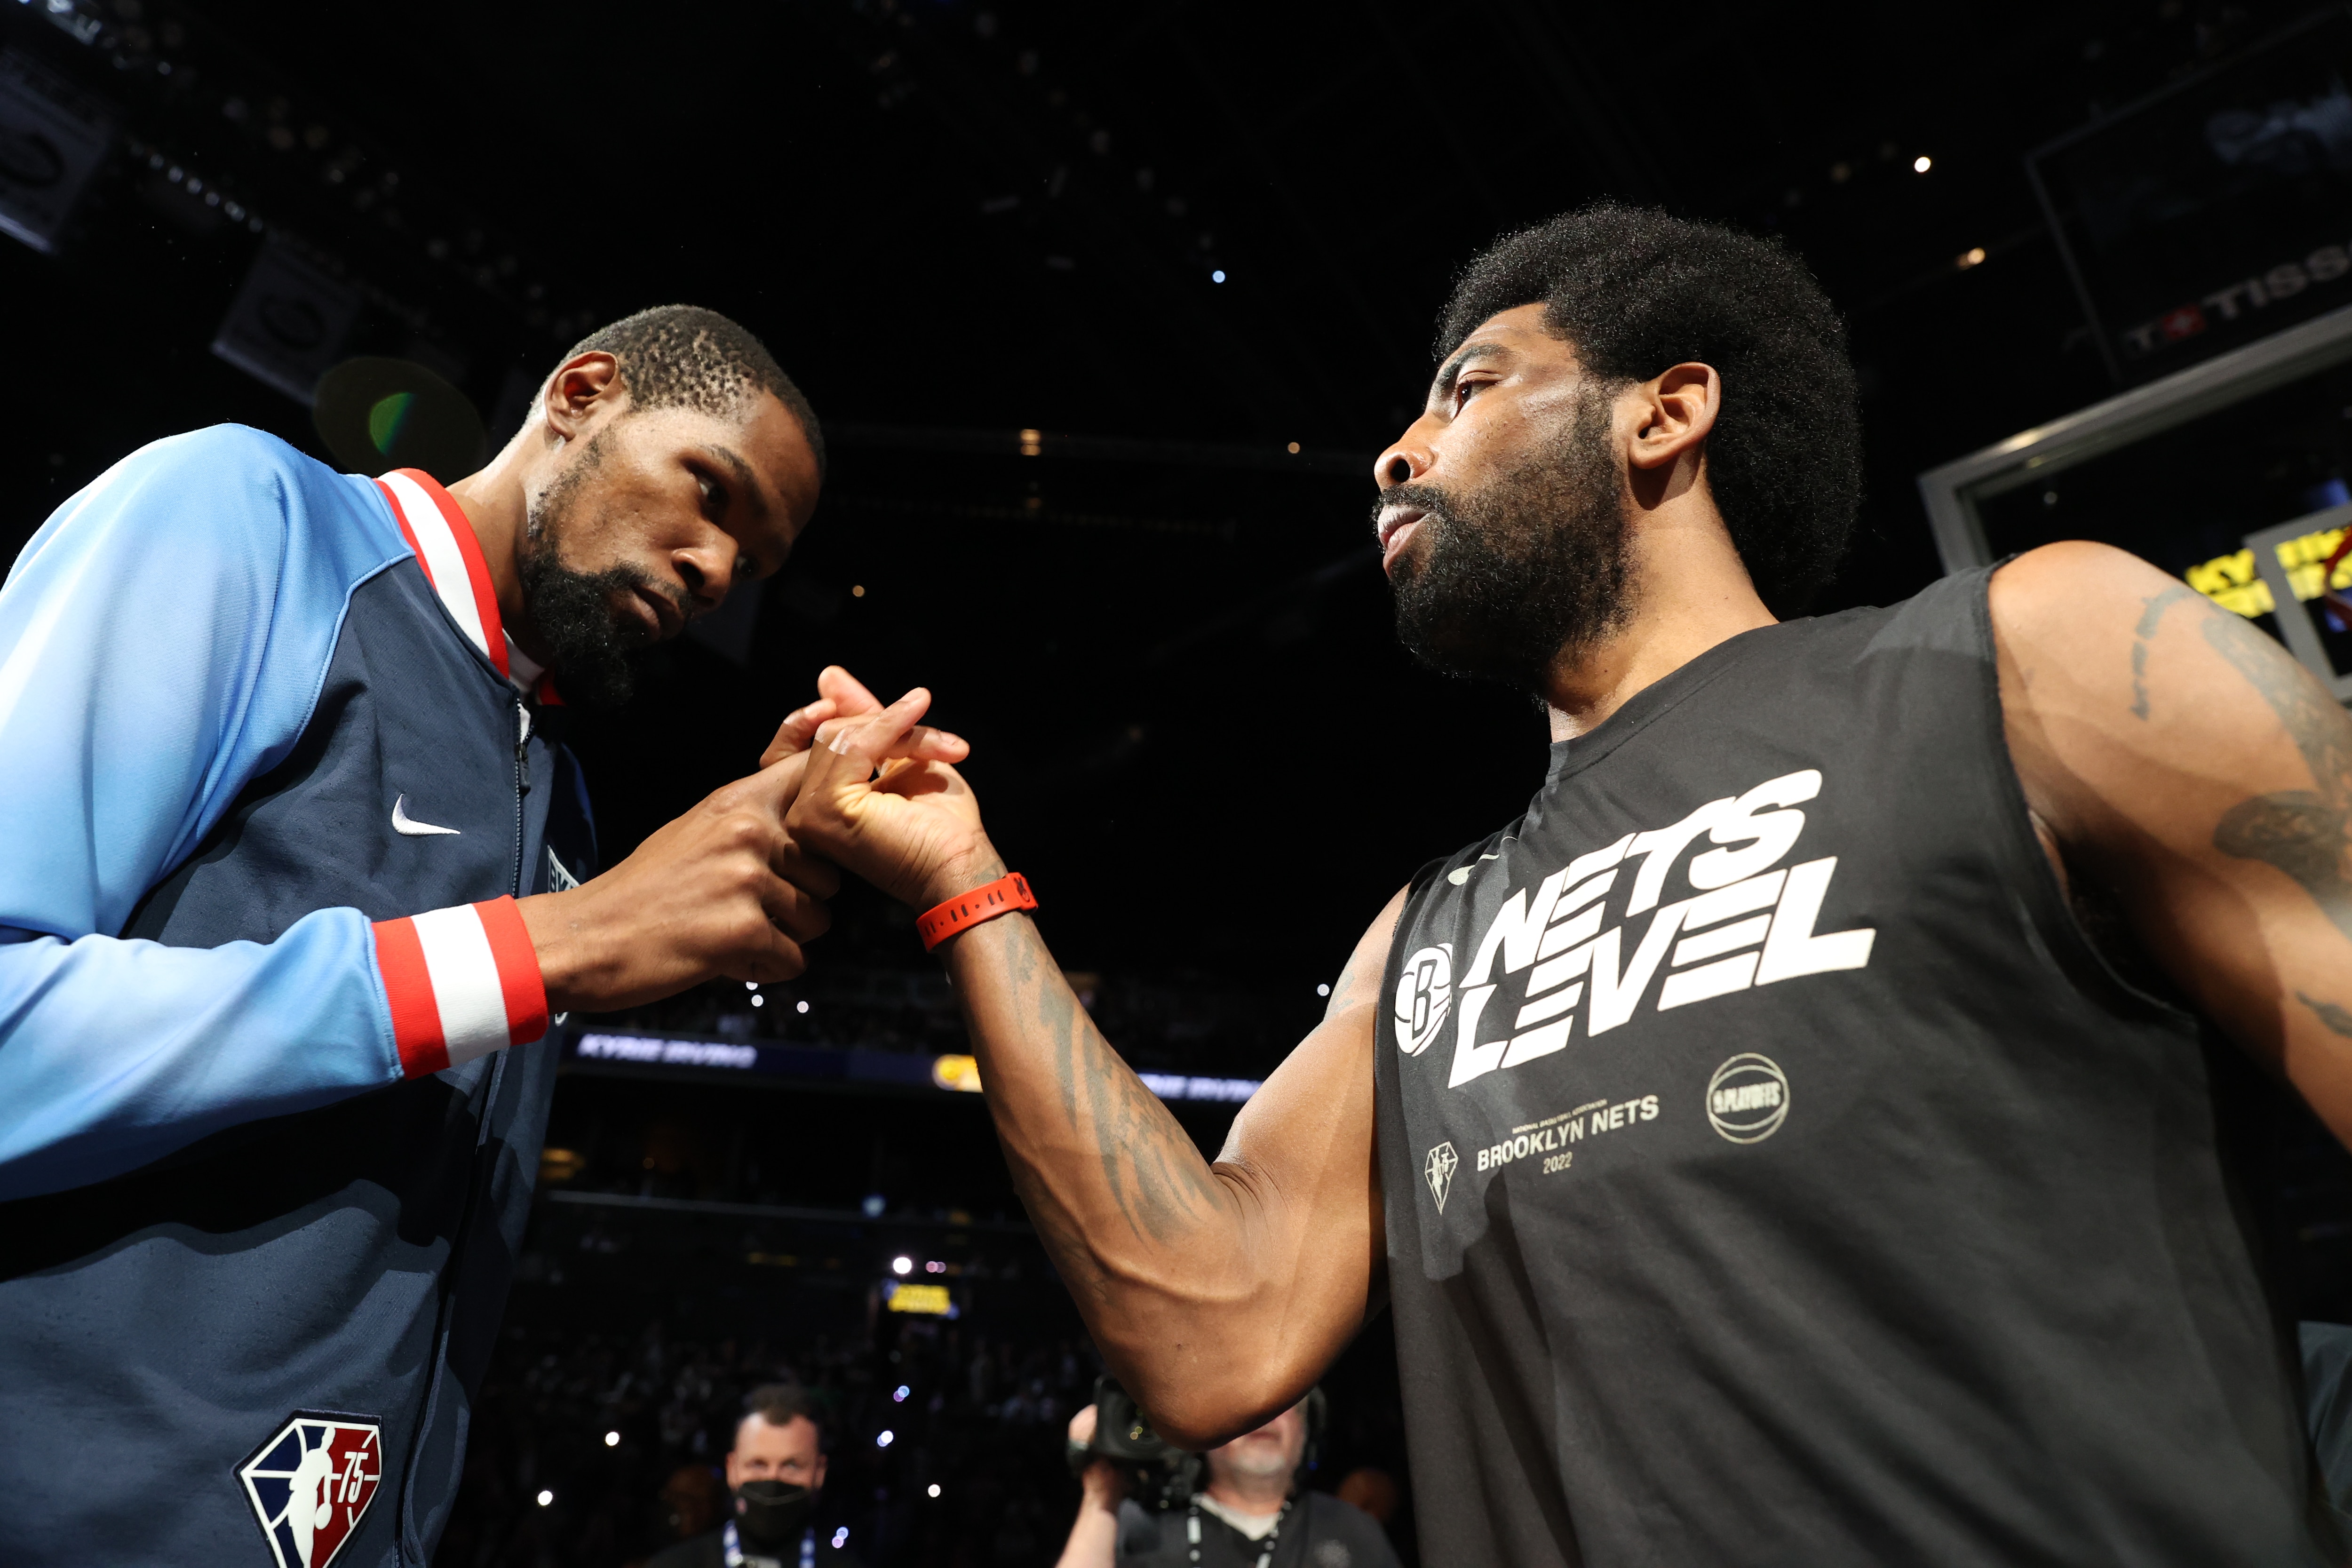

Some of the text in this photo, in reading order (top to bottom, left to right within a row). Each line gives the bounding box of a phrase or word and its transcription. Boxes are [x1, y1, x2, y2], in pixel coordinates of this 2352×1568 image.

[2201, 238, 2352, 321] TISS
[1459, 769, 1822, 987] NETS
[1448, 856, 1876, 1089] LEVEL
[1477, 1094, 1660, 1171] BROOKLYN NETS
[1543, 1151, 1573, 1174] 2022
[337, 1451, 369, 1503] 75
